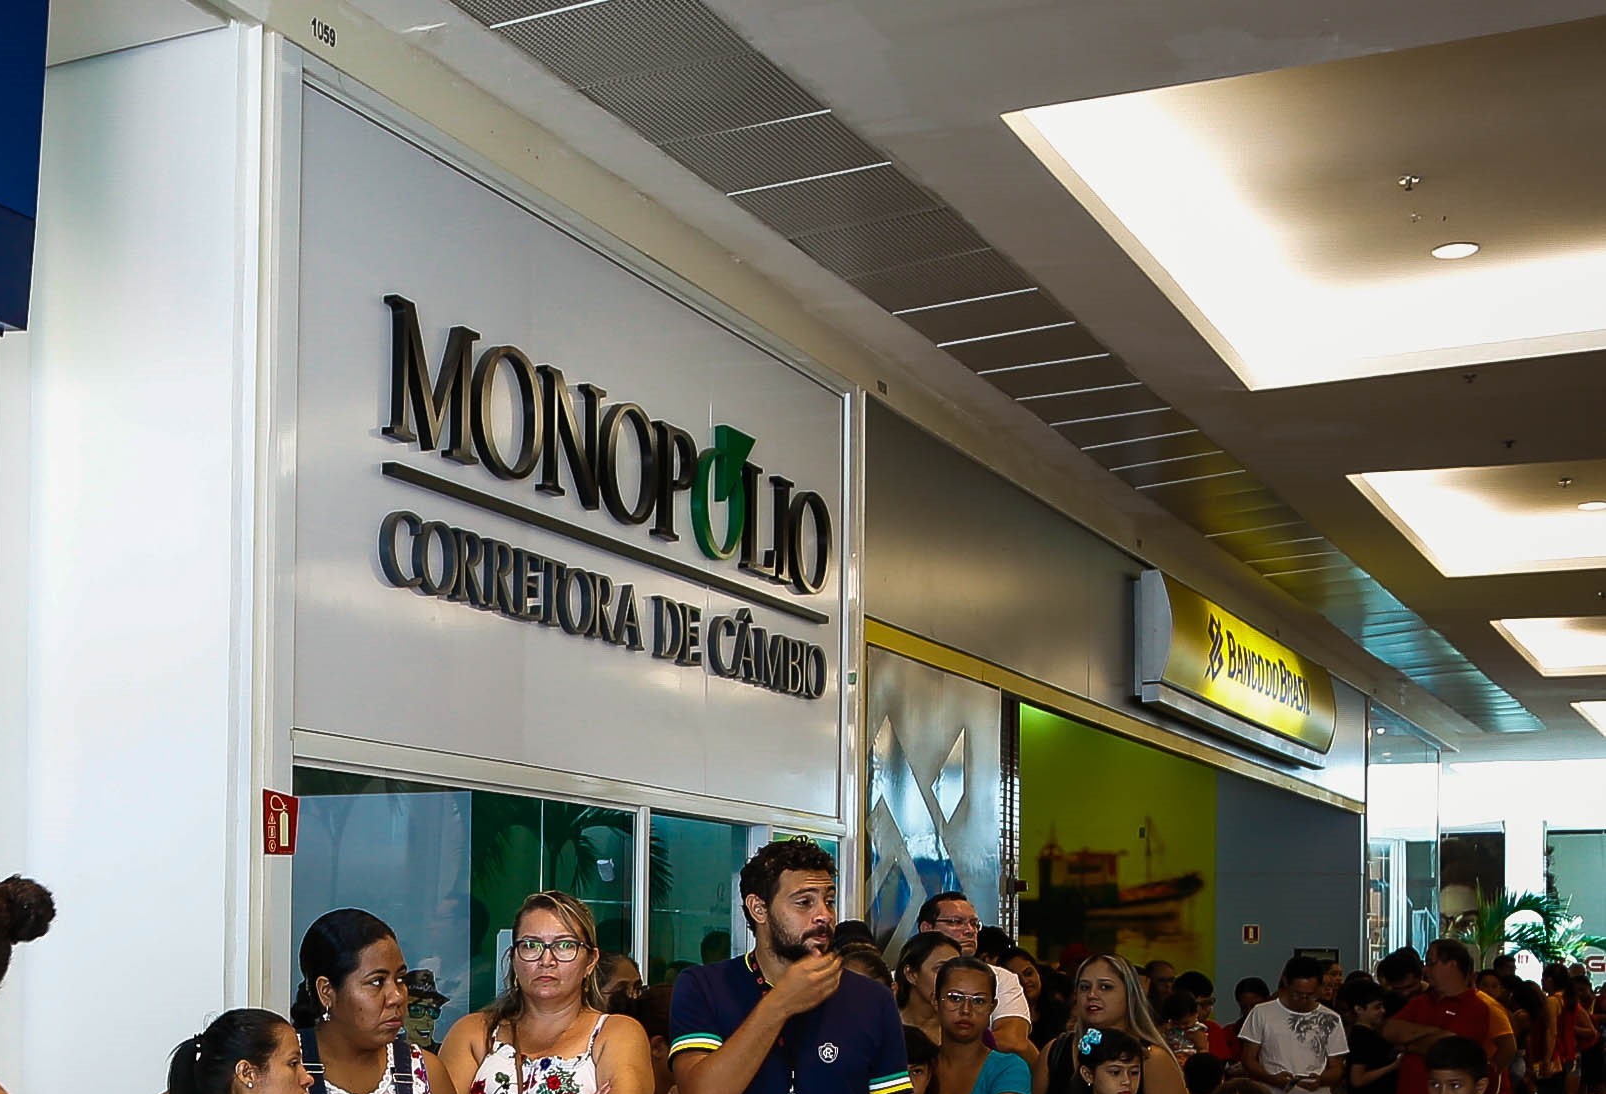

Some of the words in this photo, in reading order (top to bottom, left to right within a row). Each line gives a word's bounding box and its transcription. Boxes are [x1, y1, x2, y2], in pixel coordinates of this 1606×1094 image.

[311, 17, 336, 48] 1059
[378, 510, 645, 652] CORRETORA
[651, 594, 702, 666] DE
[708, 607, 828, 700] CÂMBIO
[1226, 629, 1265, 694] BANCO
[1278, 657, 1311, 716] BRASIL
